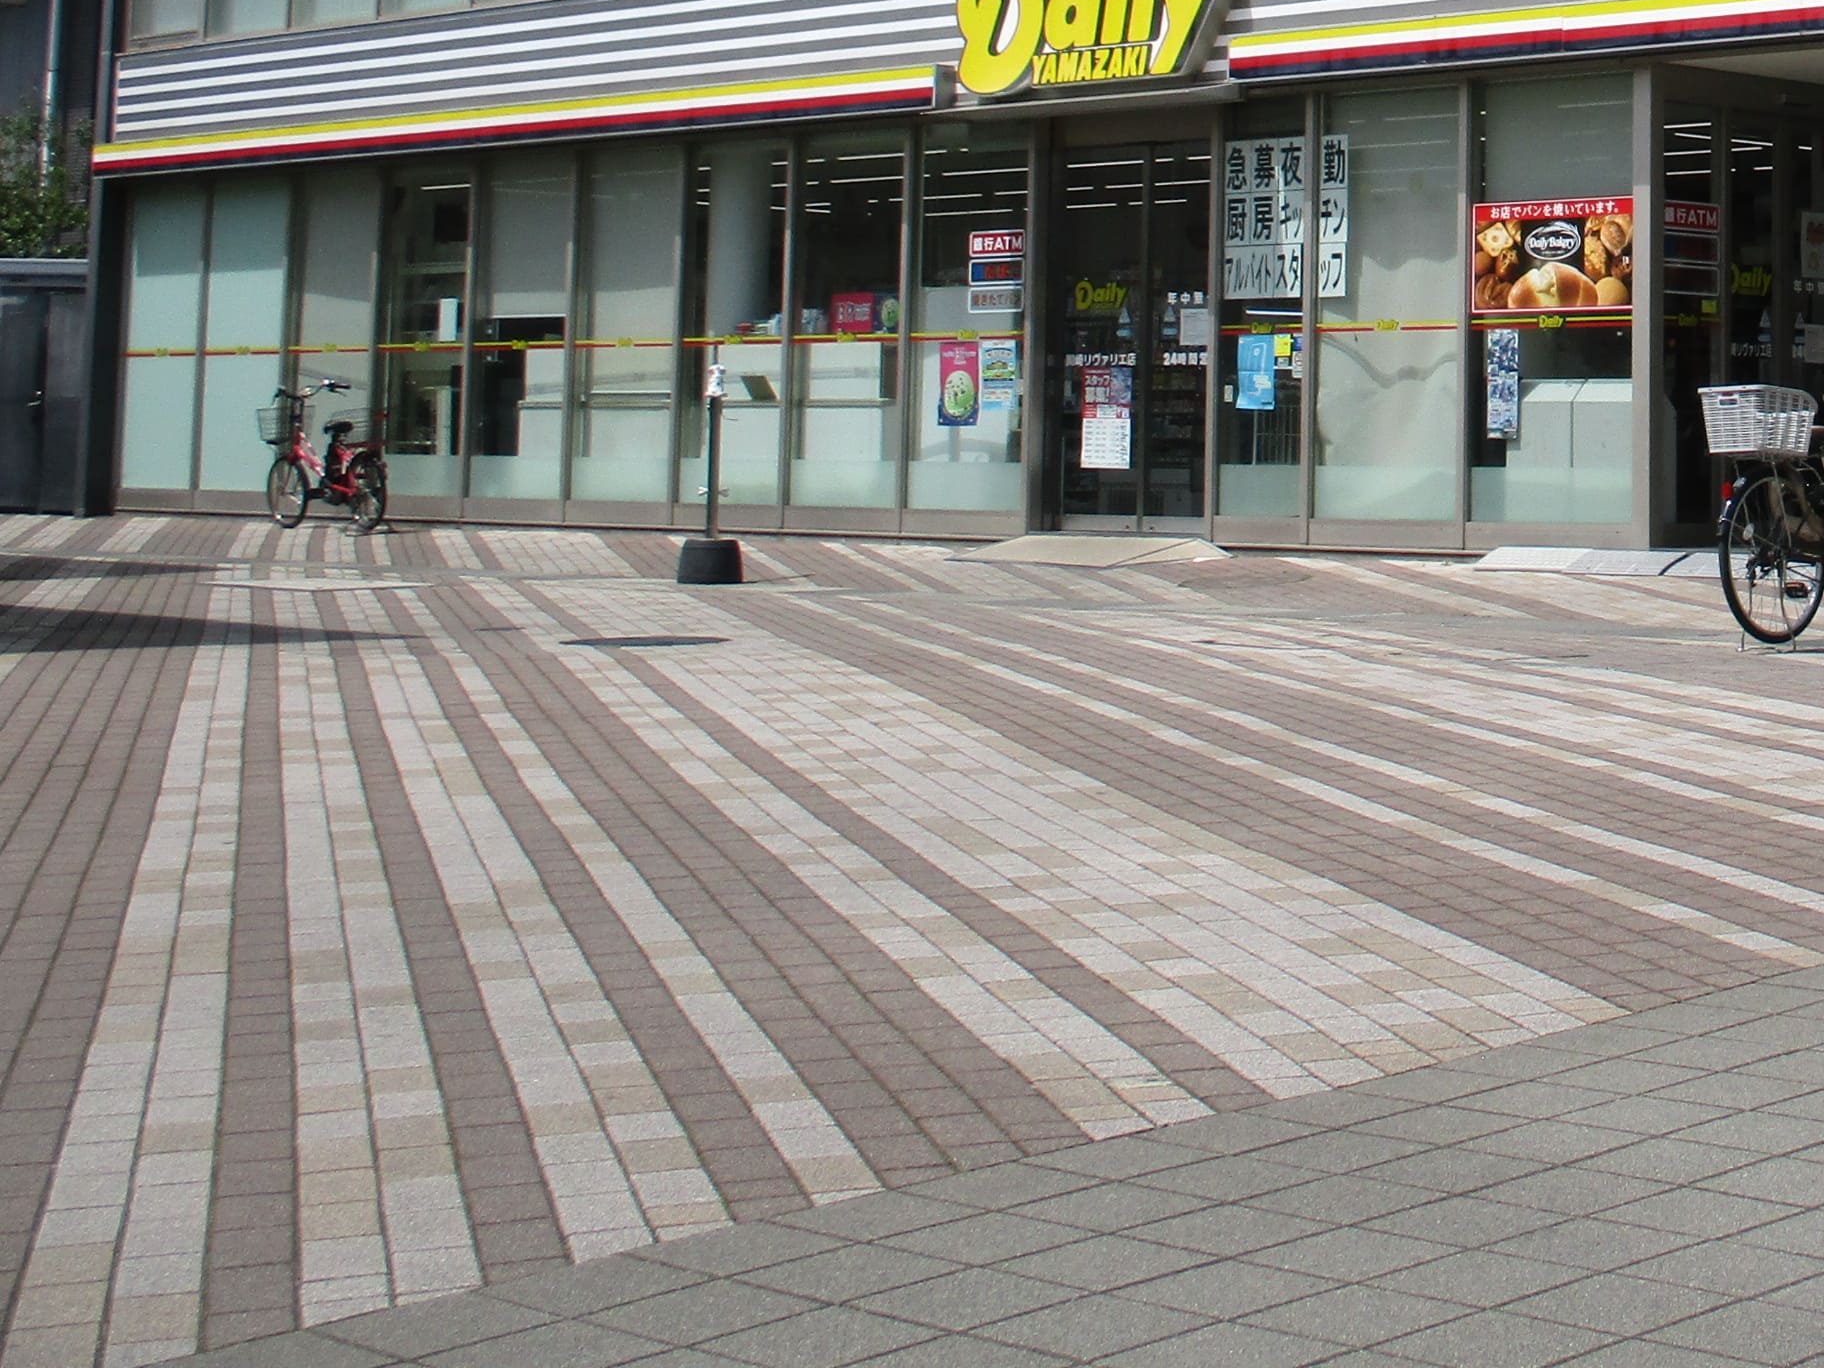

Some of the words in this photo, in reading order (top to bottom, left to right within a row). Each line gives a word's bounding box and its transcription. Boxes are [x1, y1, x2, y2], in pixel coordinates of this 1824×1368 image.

[1032, 44, 1151, 85] YAMAZAKI
[1226, 139, 1346, 190] 急募夜勤
[1226, 195, 1346, 241] 厨房キッチン
[1490, 201, 1619, 220] お店でパンを焼いています。
[1225, 248, 1343, 295] アルバイトスタッフ
[1076, 281, 1129, 311] Daily
